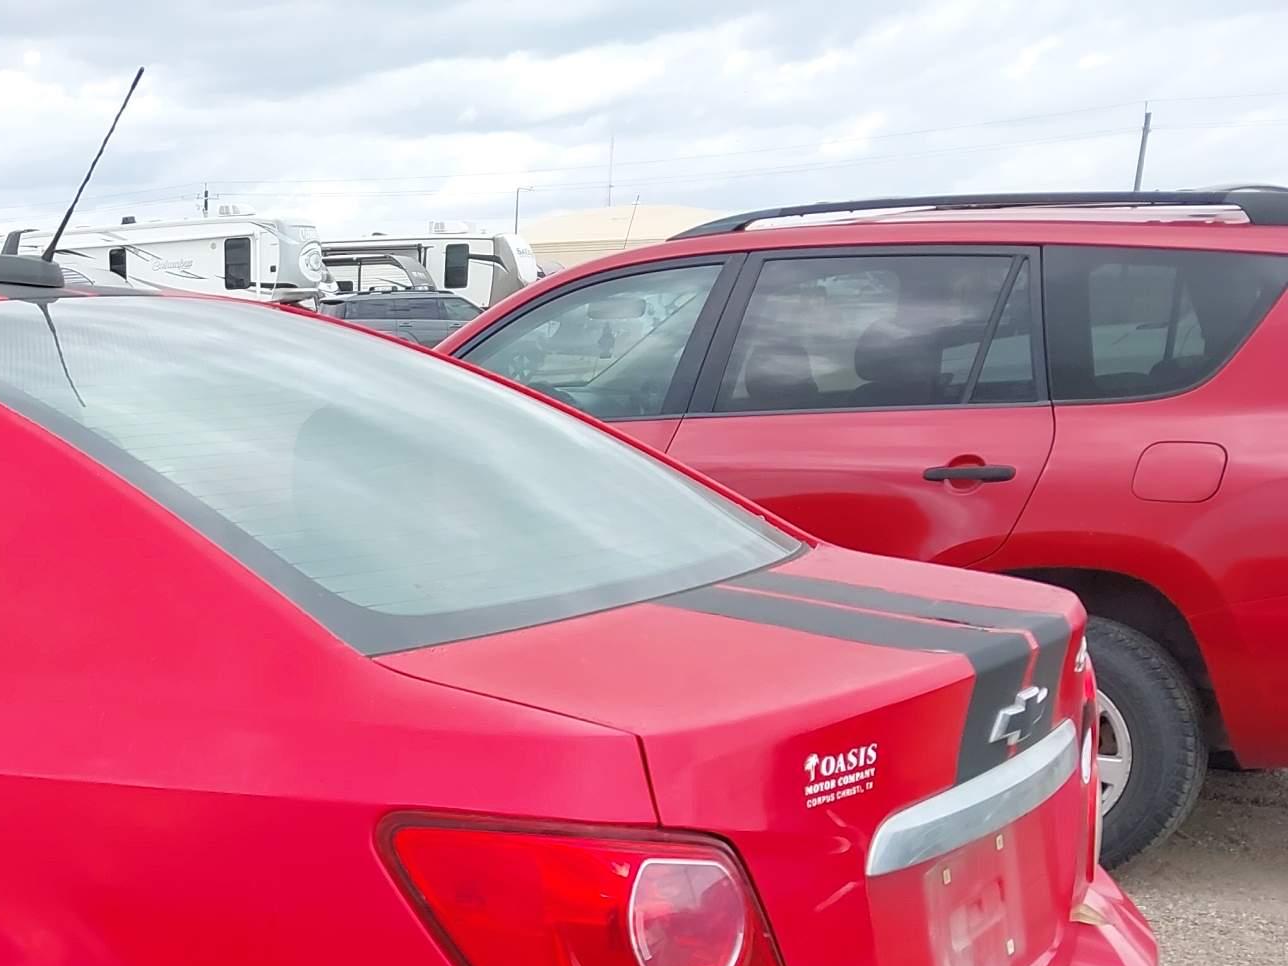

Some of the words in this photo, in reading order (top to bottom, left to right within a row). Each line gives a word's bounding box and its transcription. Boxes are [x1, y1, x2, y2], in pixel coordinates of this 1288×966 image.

[821, 743, 877, 776] OASIS
[805, 780, 836, 795] MOTOR
[838, 768, 875, 786] COMPANY
[807, 793, 834, 808] CORPUS
